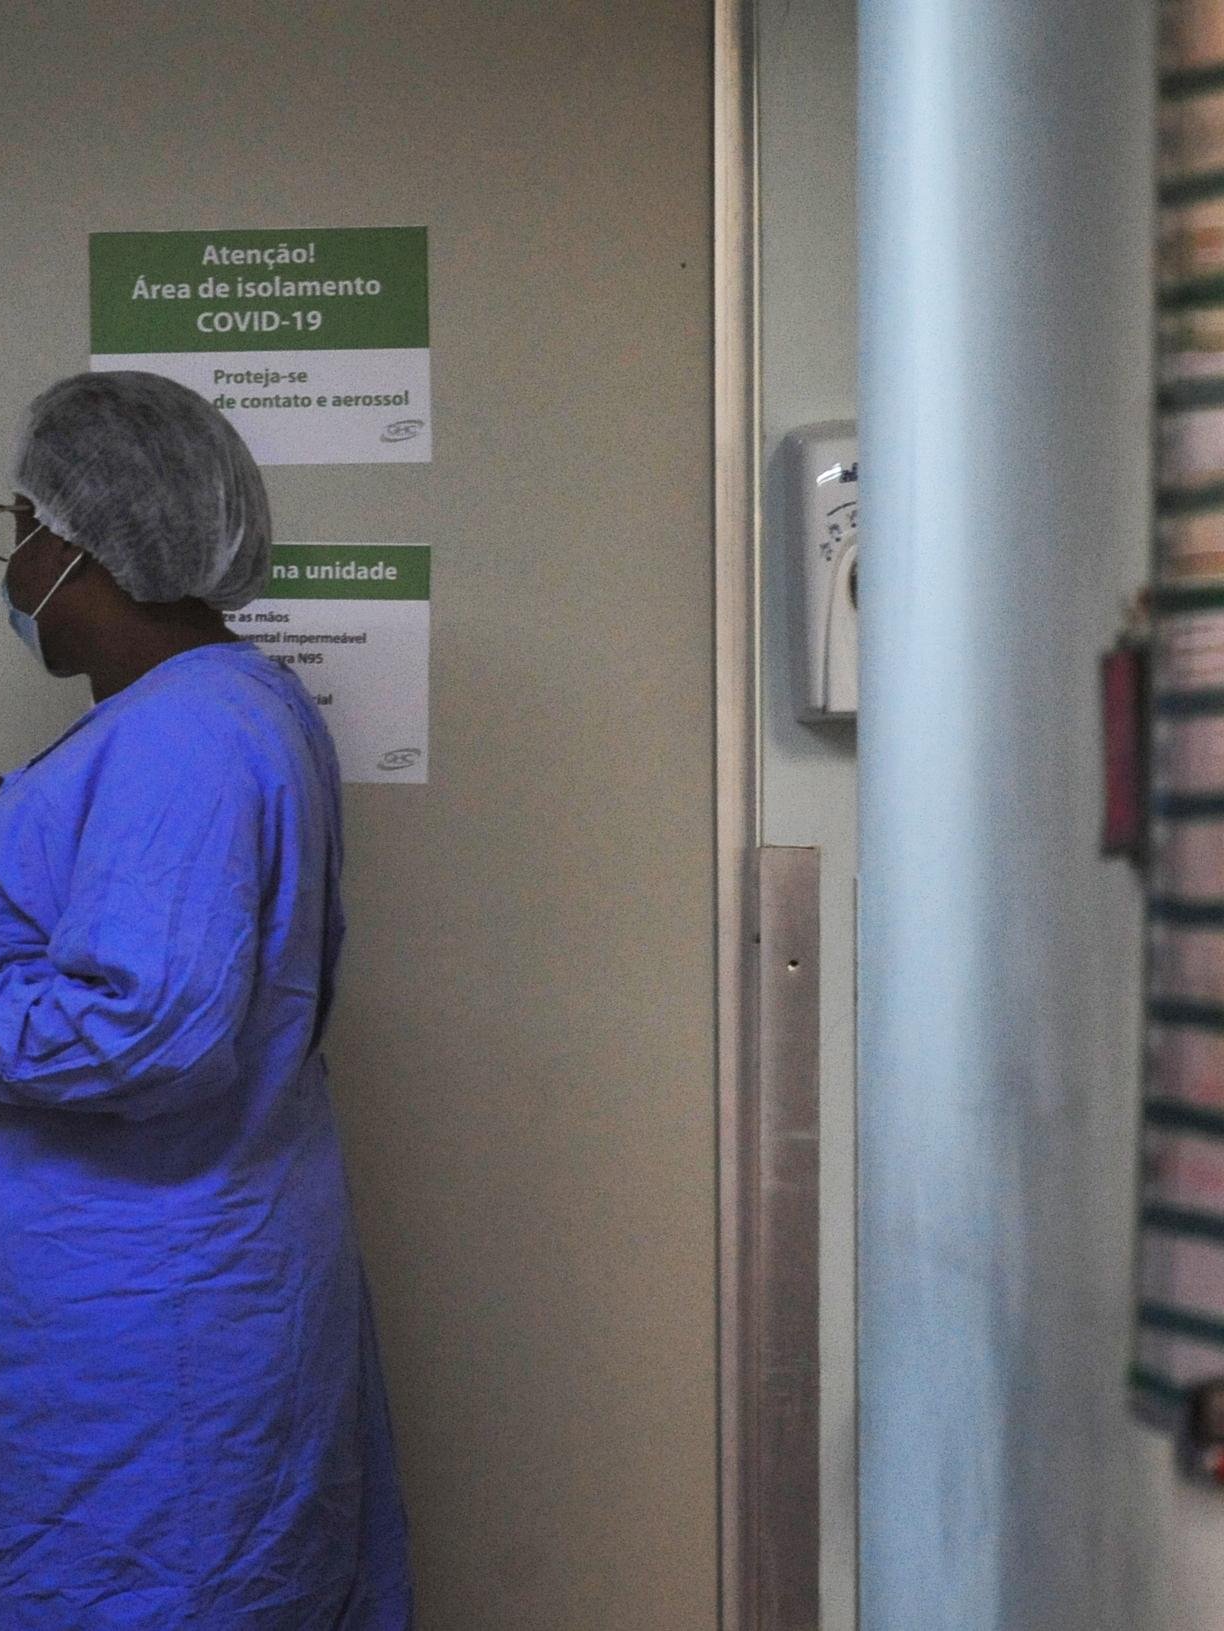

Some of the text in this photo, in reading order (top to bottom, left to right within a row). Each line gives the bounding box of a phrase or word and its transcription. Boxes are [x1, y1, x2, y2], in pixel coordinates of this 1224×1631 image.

[201, 242, 316, 269] Atenção!
[131, 274, 381, 300] Área de isolamento
[196, 310, 322, 333] COVID-19
[213, 369, 308, 388] Proteja-se
[214, 390, 410, 409] de contato e aerossol
[272, 560, 398, 580] na unidade
[238, 613, 253, 623] as
[255, 611, 290, 624] mãos
[239, 631, 367, 646] vental impermeável
[298, 652, 324, 664] N95
